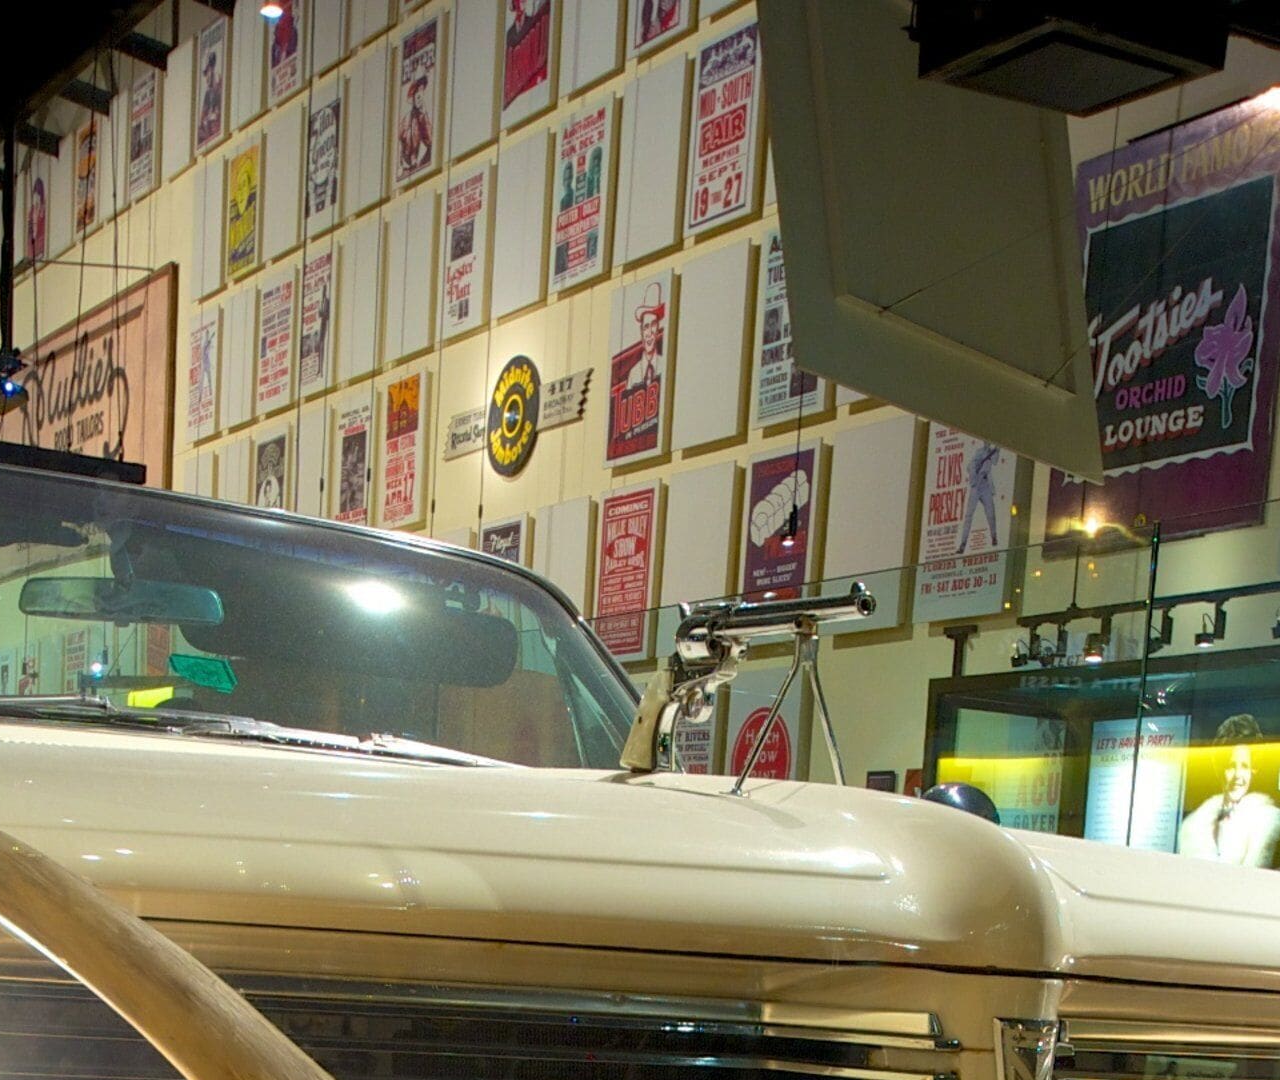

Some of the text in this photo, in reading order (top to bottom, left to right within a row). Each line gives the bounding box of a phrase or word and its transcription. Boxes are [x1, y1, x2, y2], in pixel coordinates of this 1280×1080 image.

[701, 109, 745, 152] FAIR
[702, 144, 739, 169] MEMPHIS
[693, 187, 709, 221] 19
[723, 171, 743, 209] 27
[1088, 151, 1172, 214] WORLD
[768, 263, 785, 286] TUE
[1089, 276, 1223, 400] Tootsies
[494, 363, 534, 408] Midnite
[1116, 374, 1186, 410] ORCHID
[611, 380, 660, 438] TUBB
[1104, 405, 1204, 446] LOUNGE
[936, 453, 964, 489] ELVIS
[608, 500, 648, 517] COMING
[927, 487, 967, 527] PRESLEY
[951, 576, 971, 592] AUG
[745, 729, 780, 746] HCH
[1096, 738, 1117, 750] LET'S
[1147, 733, 1175, 746] PARTY
